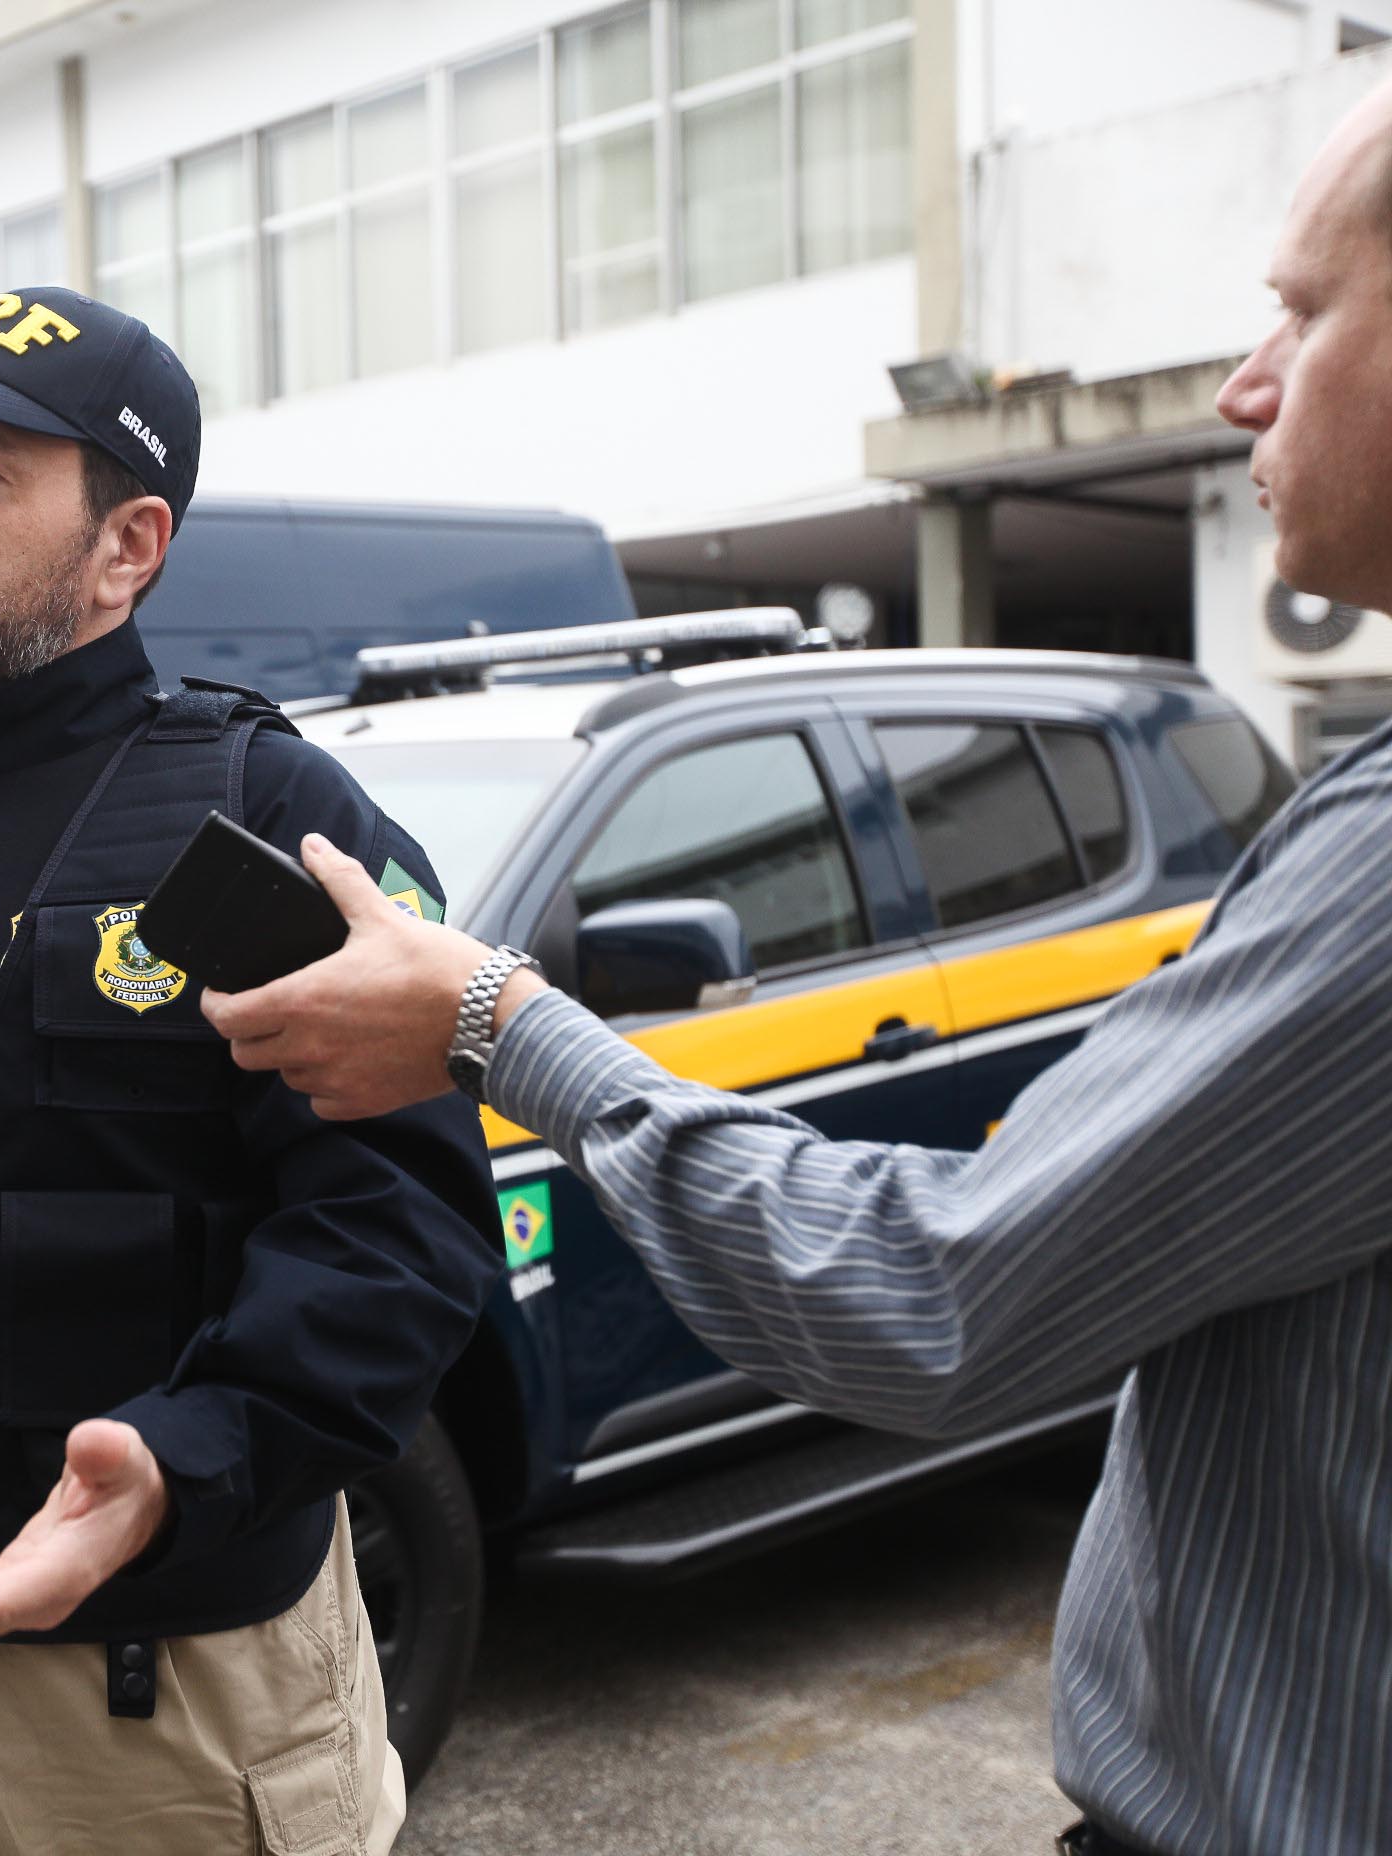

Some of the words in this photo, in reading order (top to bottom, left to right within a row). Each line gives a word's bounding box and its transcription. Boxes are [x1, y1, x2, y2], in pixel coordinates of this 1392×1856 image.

[117, 406, 168, 468] BRASIL
[108, 910, 138, 925] POL
[115, 990, 165, 1002] FEDERAL
